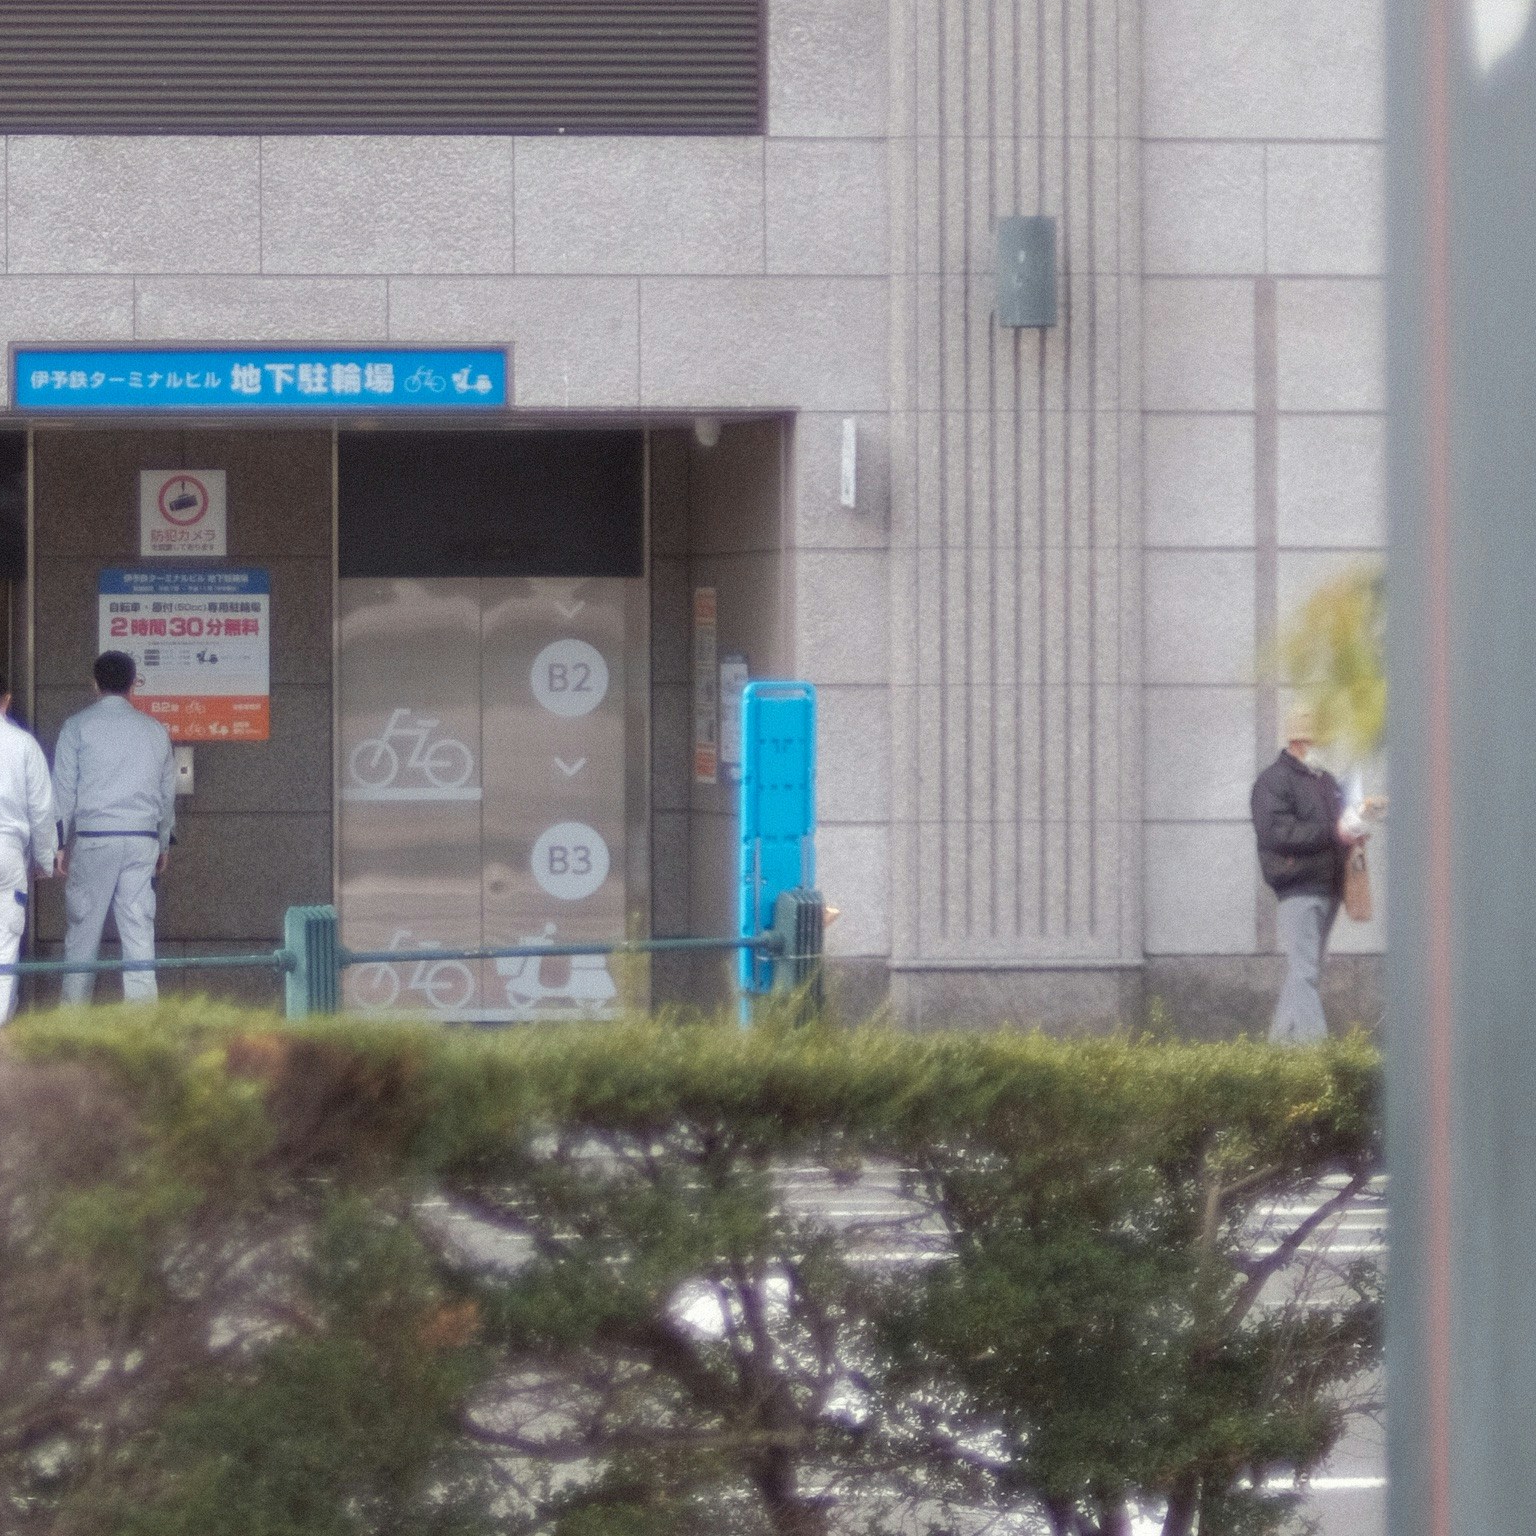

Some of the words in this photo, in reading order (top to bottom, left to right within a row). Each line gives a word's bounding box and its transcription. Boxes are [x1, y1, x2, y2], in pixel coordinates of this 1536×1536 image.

[230, 363, 394, 394] 地下駐輪場
[150, 529, 216, 542] 防犯カメラ
[110, 616, 260, 637] 2時間30分無料
[547, 663, 593, 693] B2
[548, 845, 593, 875] B3
